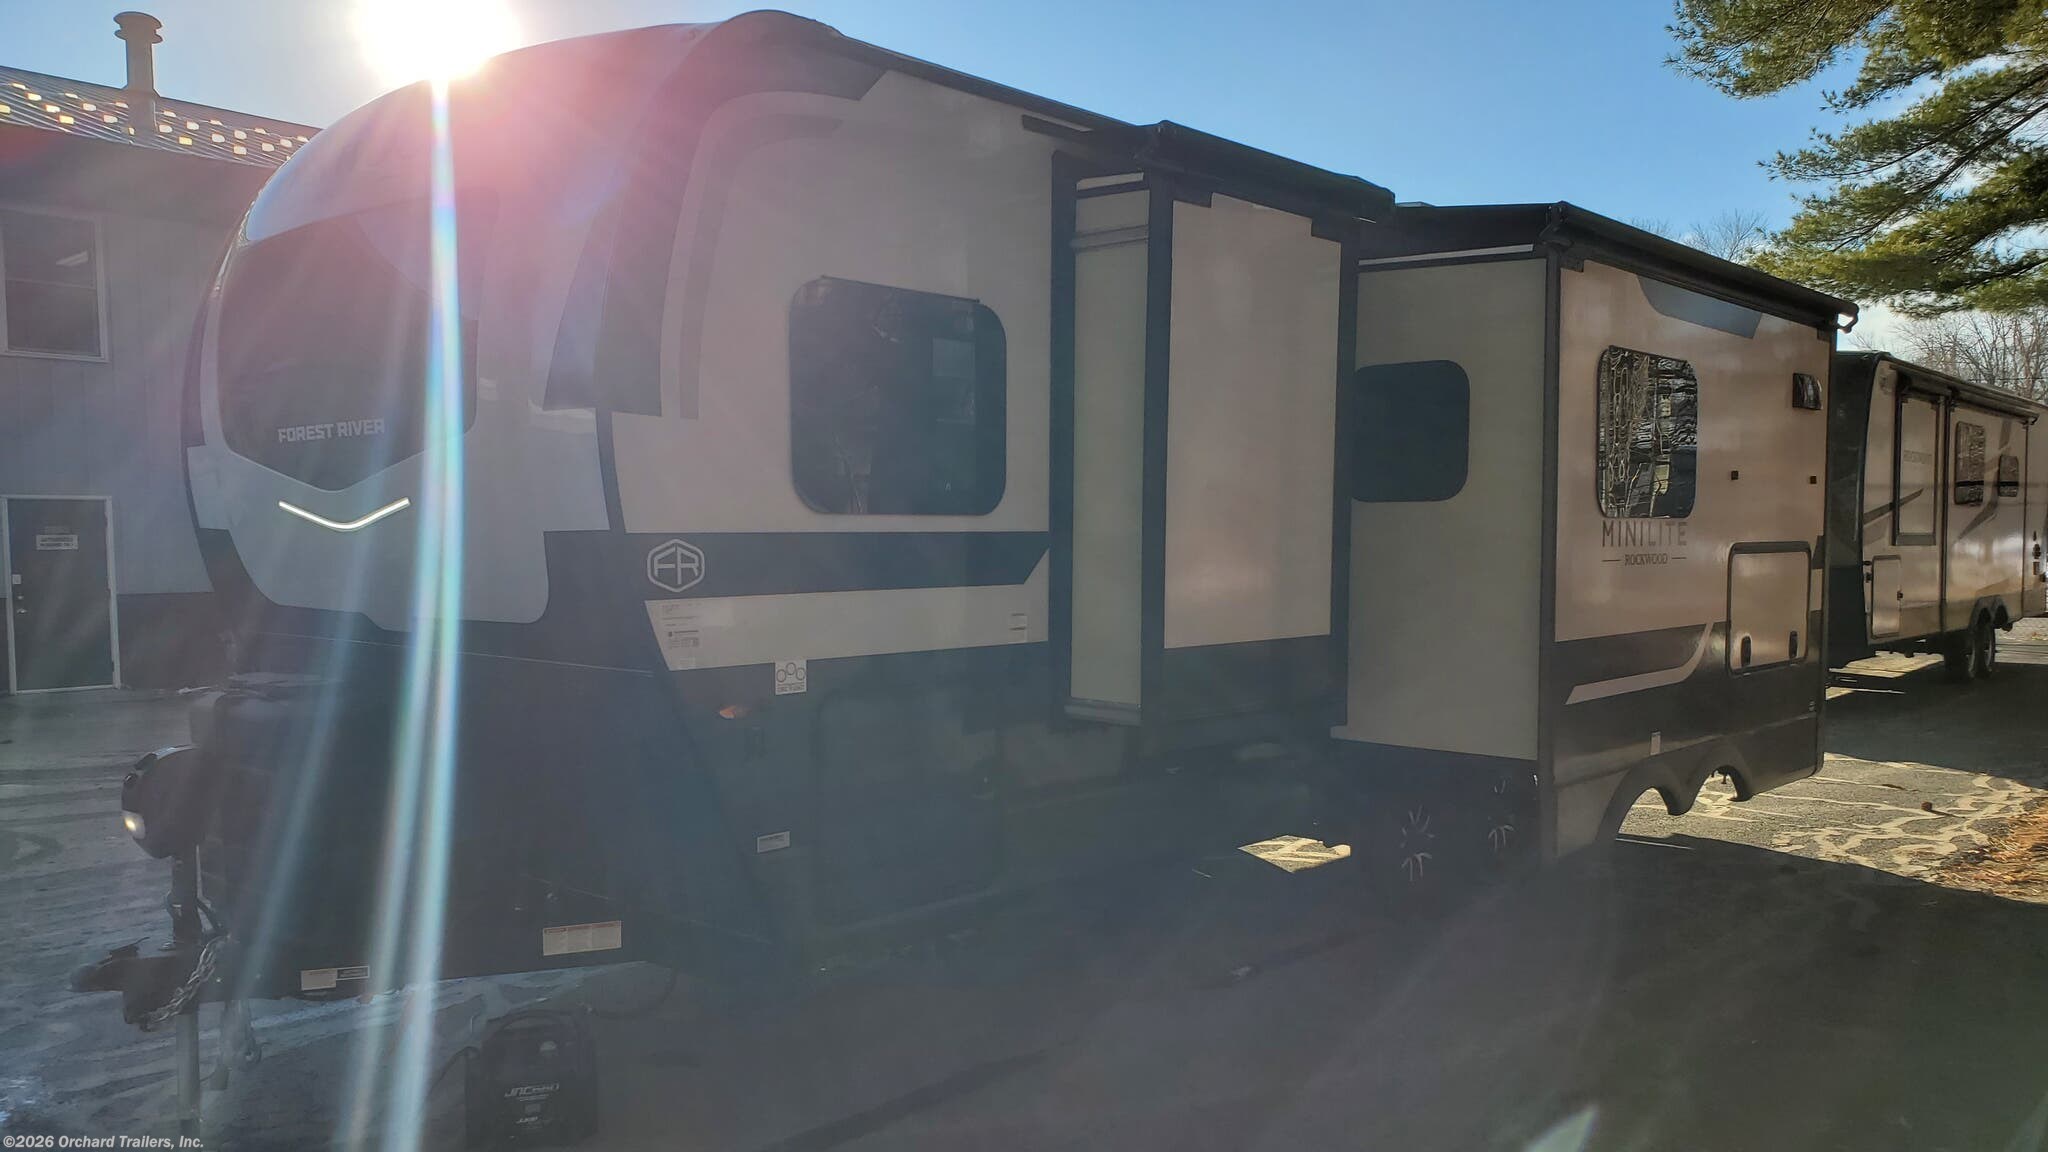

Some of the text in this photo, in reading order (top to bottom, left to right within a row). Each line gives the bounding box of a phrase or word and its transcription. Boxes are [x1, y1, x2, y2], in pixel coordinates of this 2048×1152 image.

[277, 418, 385, 443] FOREST RIVER
[1602, 520, 1688, 547] MINILITE
[1624, 552, 1669, 566] ROCKWOOD
